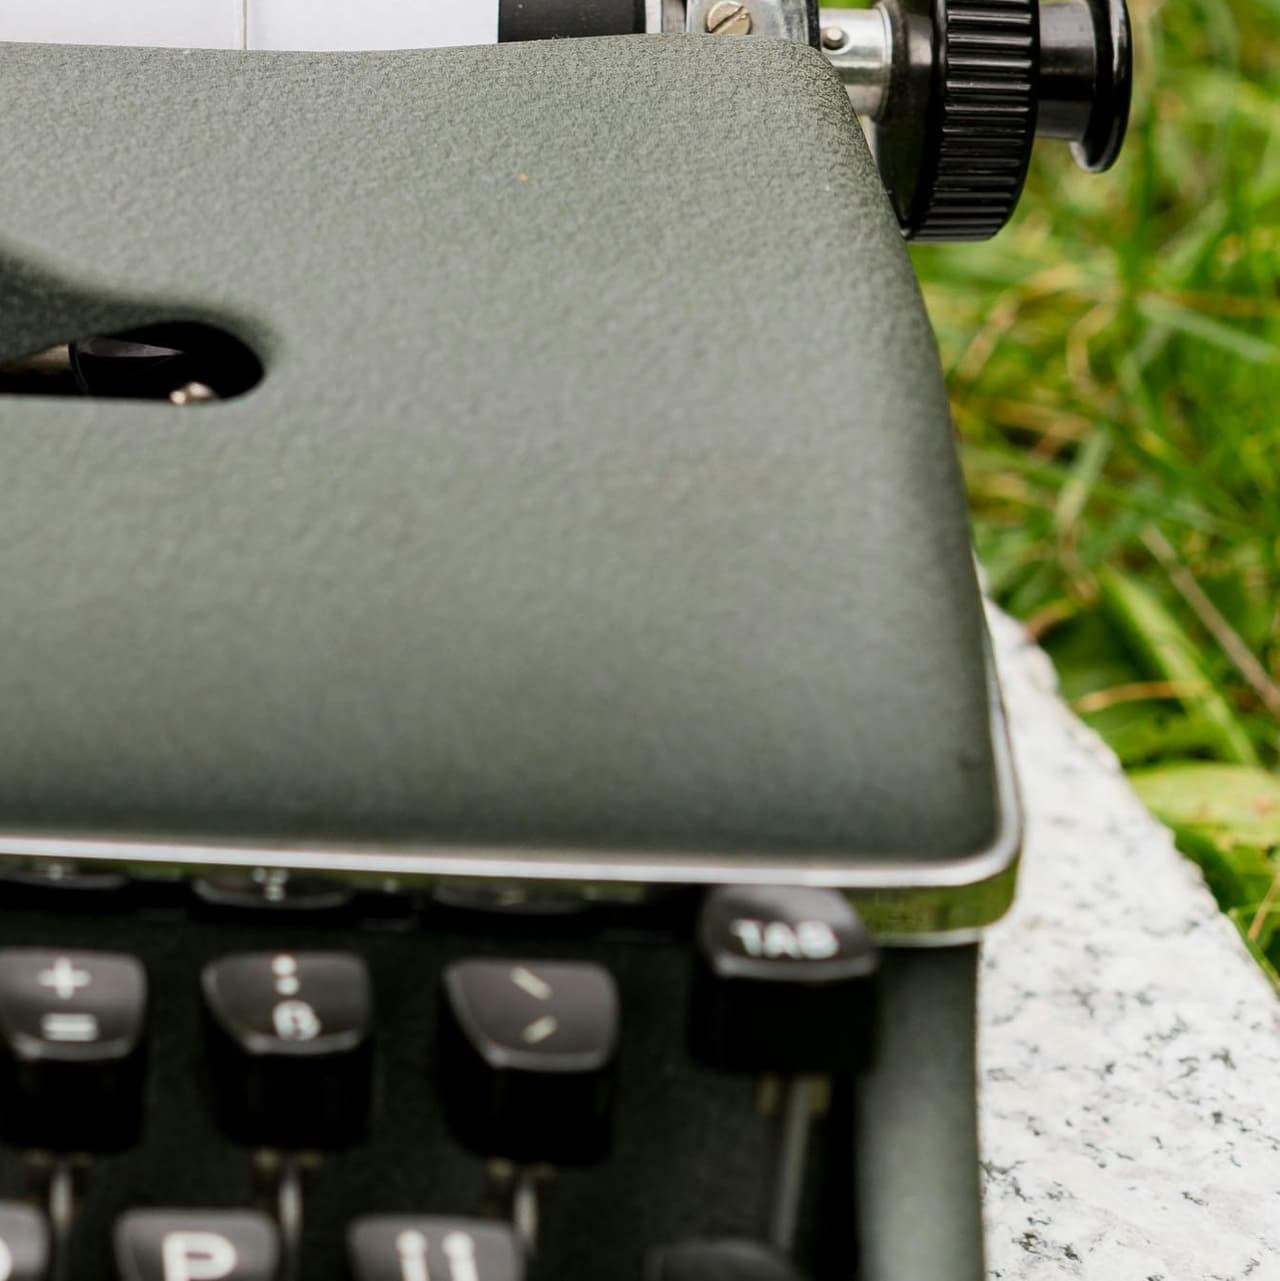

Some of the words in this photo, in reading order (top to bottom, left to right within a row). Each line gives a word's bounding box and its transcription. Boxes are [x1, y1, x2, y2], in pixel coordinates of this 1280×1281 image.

[729, 919, 839, 960] TAB
[38, 956, 93, 999] +
[43, 1013, 98, 1042] =
[161, 1230, 238, 1281] P
